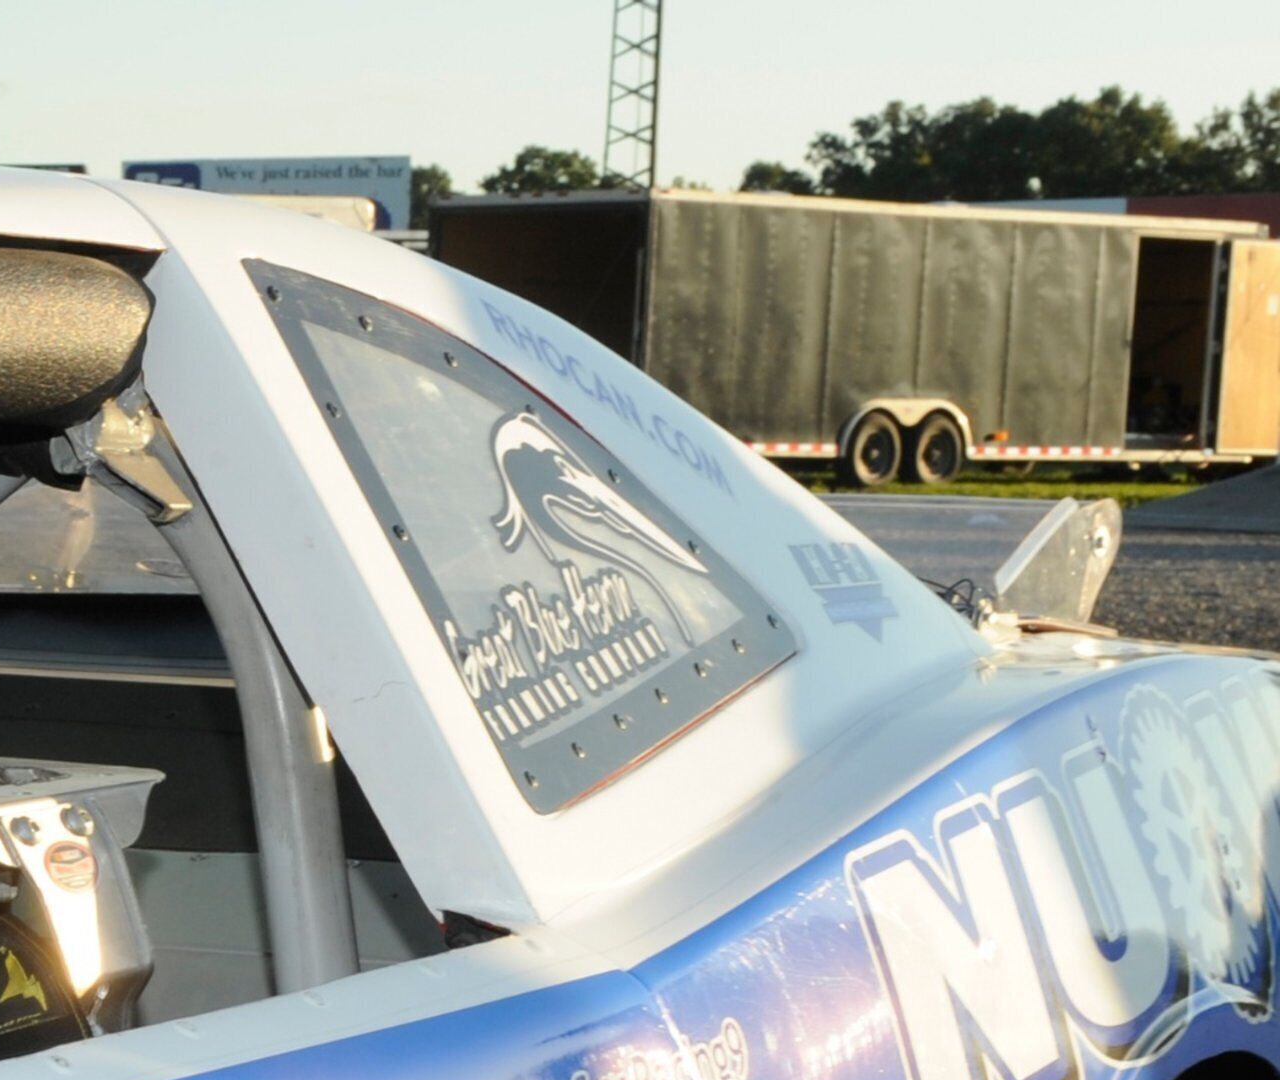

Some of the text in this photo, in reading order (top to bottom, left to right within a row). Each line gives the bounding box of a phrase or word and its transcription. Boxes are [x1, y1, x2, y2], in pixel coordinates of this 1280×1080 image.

[216, 164, 404, 183] We've just raised the bar
[480, 297, 735, 497] RHOCAN.COM
[443, 564, 634, 699] Great Blue Heron
[574, 623, 667, 691] COMPANY
